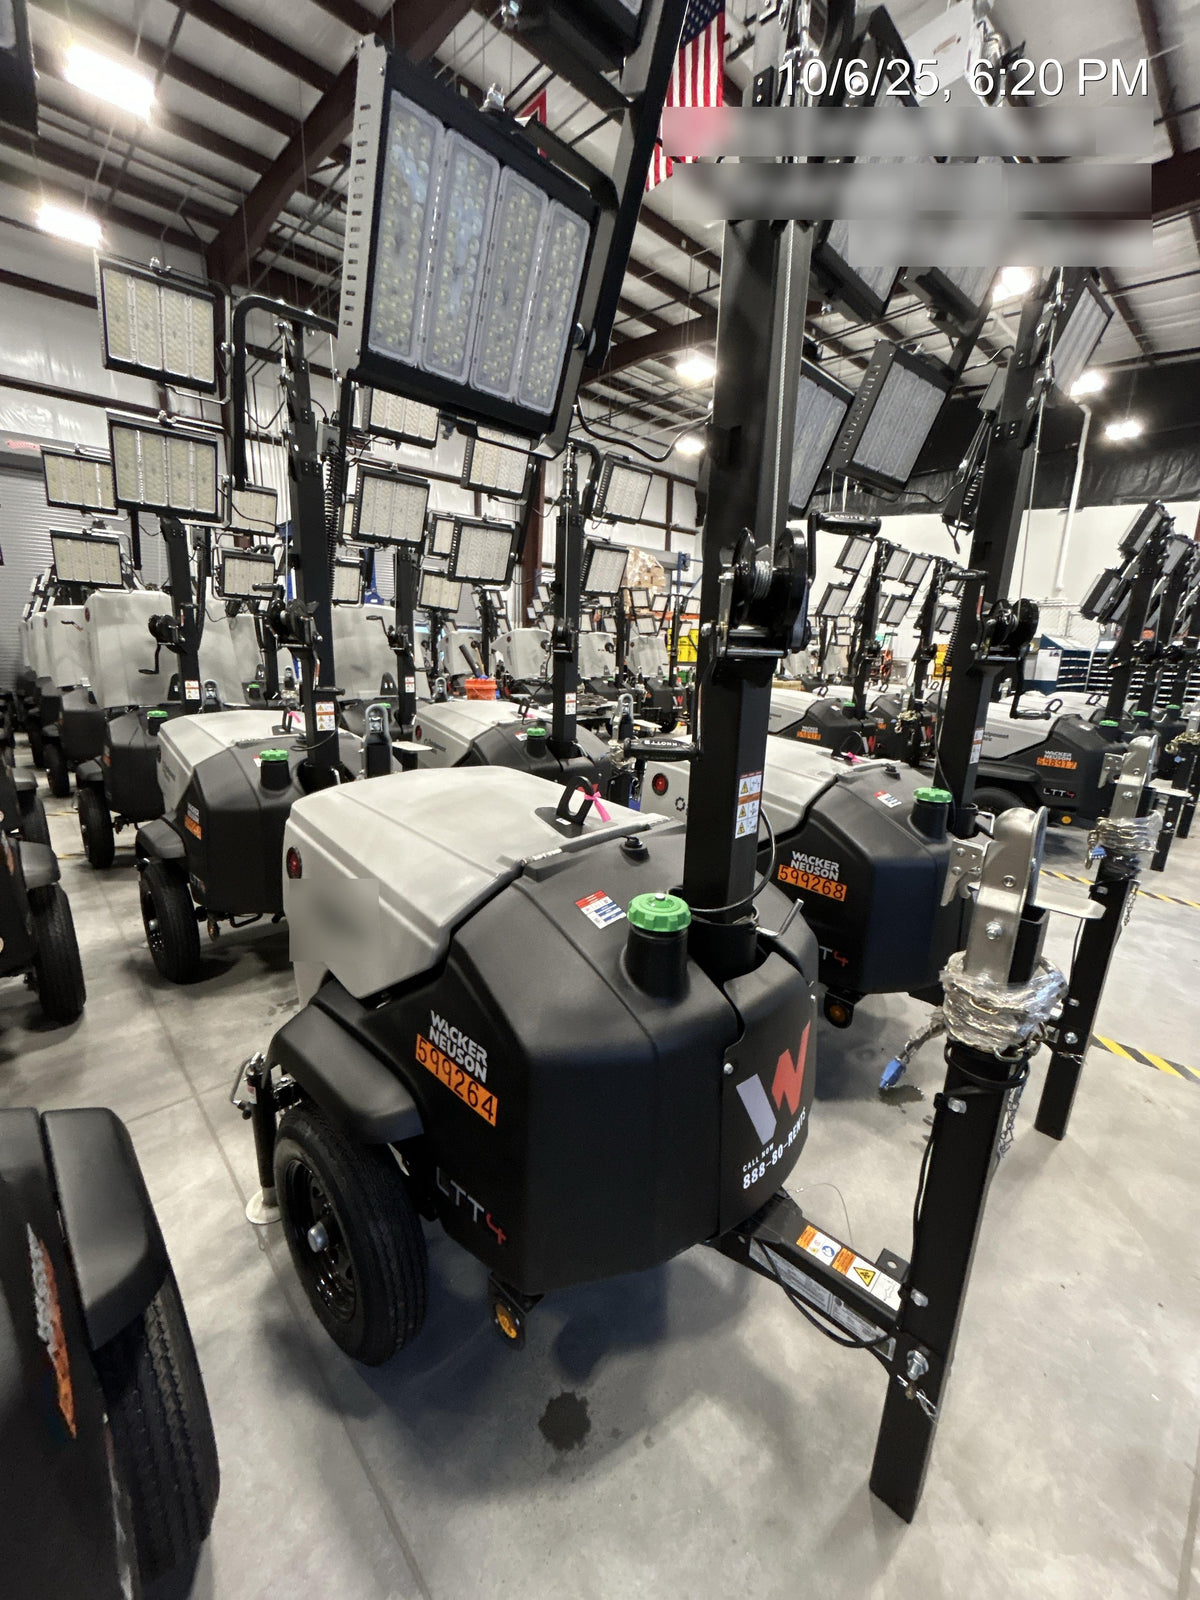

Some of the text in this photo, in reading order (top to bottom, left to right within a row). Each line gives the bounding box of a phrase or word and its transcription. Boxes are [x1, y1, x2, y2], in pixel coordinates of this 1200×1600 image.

[1043, 787, 1076, 798] LTT4
[790, 859, 839, 881] NEUSON
[791, 850, 840, 872] WACKER
[779, 865, 844, 899] 599268
[429, 1025, 488, 1083] NEUSON
[430, 1009, 488, 1066] WACKER
[417, 1038, 495, 1121] 599264
[742, 1142, 774, 1173] CALL NOW
[436, 1166, 507, 1245] LTT4
